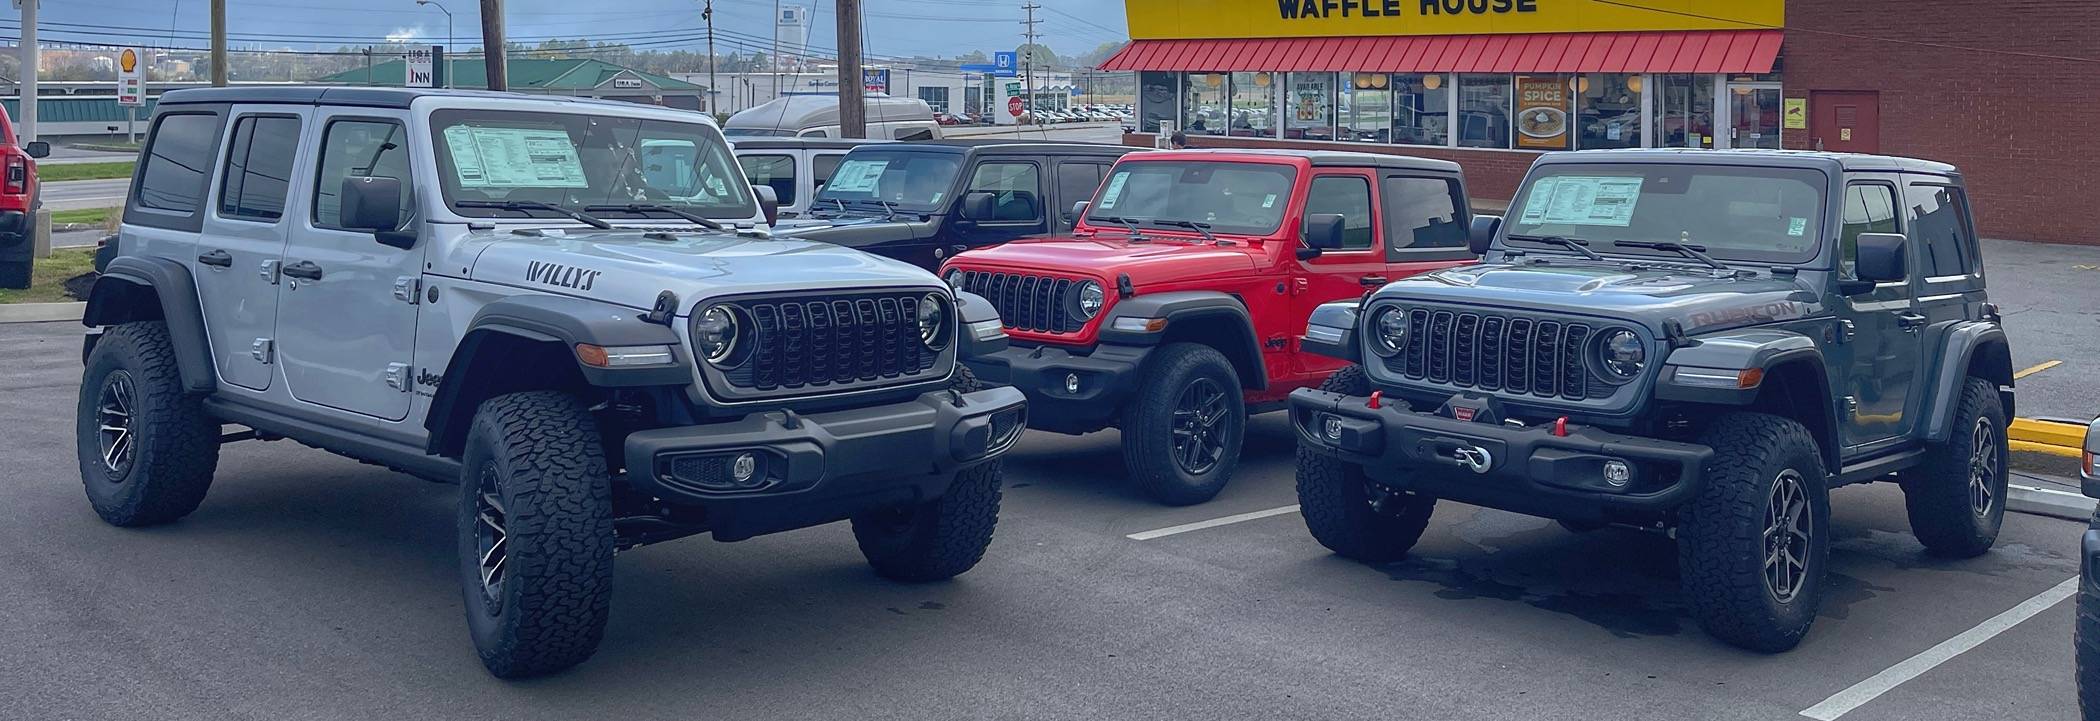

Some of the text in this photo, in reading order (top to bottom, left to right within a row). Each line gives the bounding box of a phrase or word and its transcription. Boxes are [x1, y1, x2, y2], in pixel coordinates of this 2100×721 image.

[1278, 0, 1537, 19] WAFFLE HOUSE
[408, 50, 432, 63] USA
[410, 68, 430, 83] INN
[864, 75, 885, 83] ROYAL
[1524, 90, 1561, 101] SPICE
[1009, 102, 1023, 111] STOP
[526, 260, 602, 291] WILLYS
[1689, 301, 1797, 326] RUBICON
[416, 367, 441, 388] Jee
